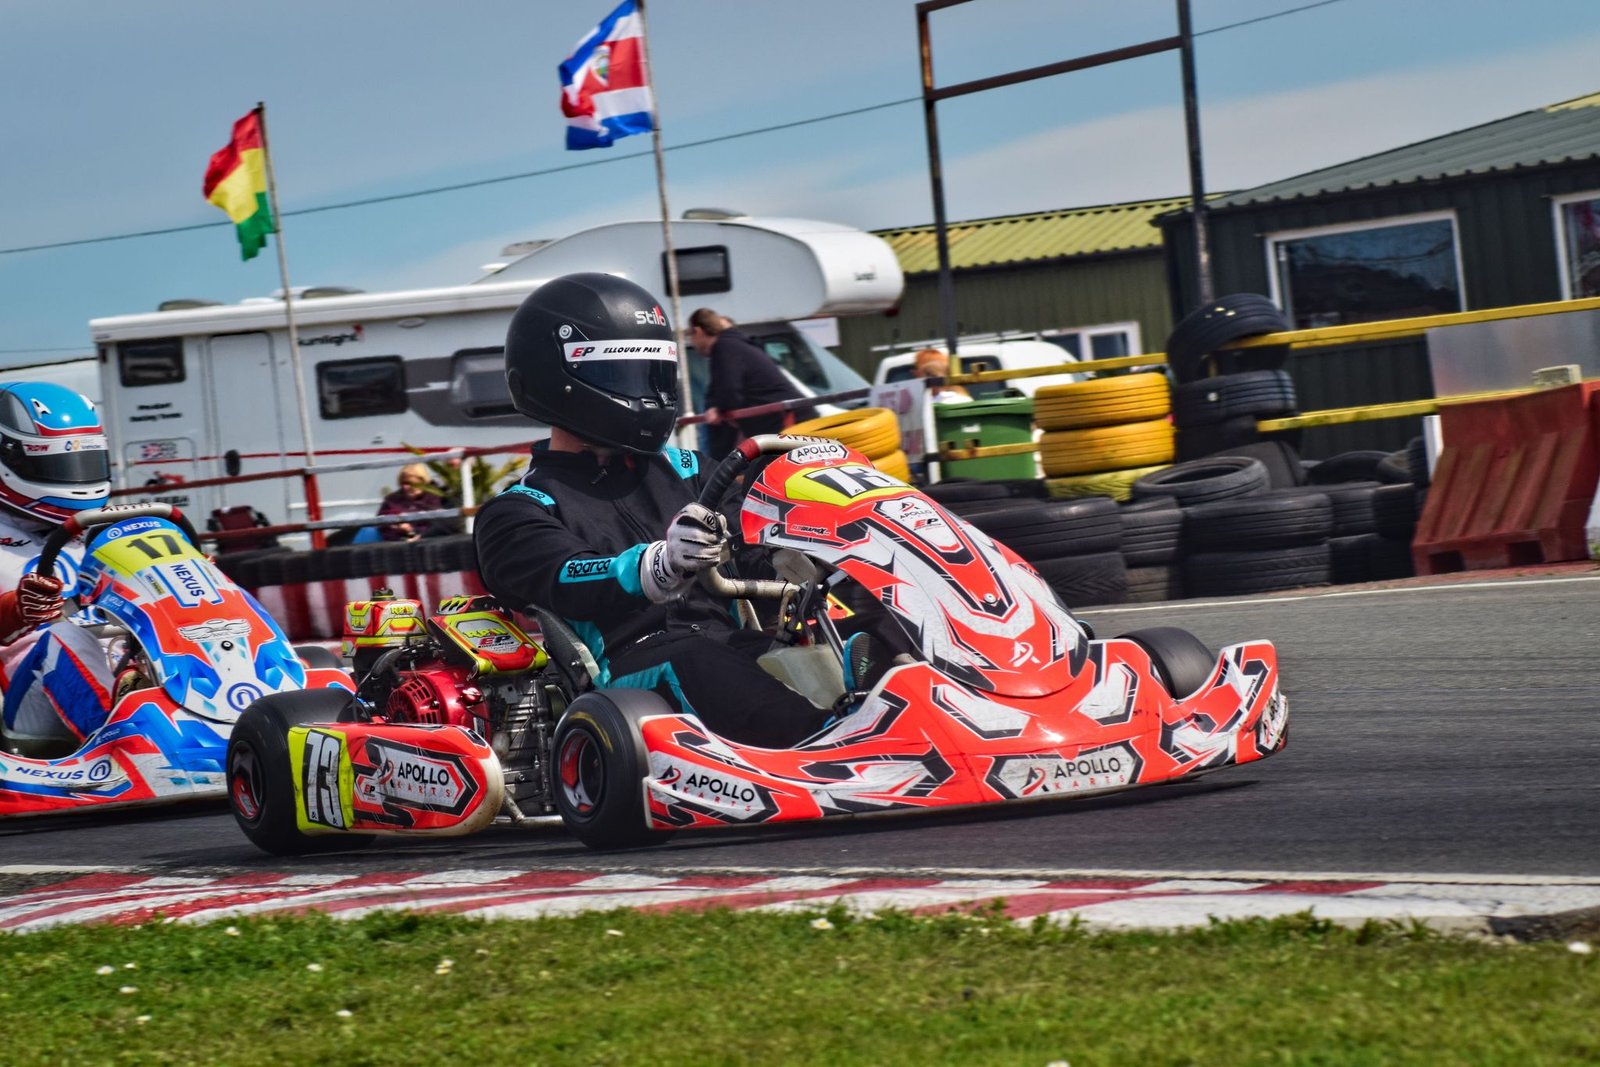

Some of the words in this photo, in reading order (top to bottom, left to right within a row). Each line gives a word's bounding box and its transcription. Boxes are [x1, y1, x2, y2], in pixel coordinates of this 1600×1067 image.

[634, 304, 666, 326] Stilo
[571, 346, 595, 358] EP
[602, 346, 642, 354] ELLOUGH
[797, 444, 838, 458] APOLLO
[122, 521, 161, 532] NEXUS
[126, 534, 183, 560] 17
[170, 564, 205, 597] NEXUS
[16, 766, 84, 779] NEXUS
[398, 761, 450, 786] APOLLO
[1054, 757, 1120, 779] APOLLO
[397, 780, 451, 798] KARTS
[686, 773, 755, 803] APOLLO
[683, 787, 752, 812] KARTS
